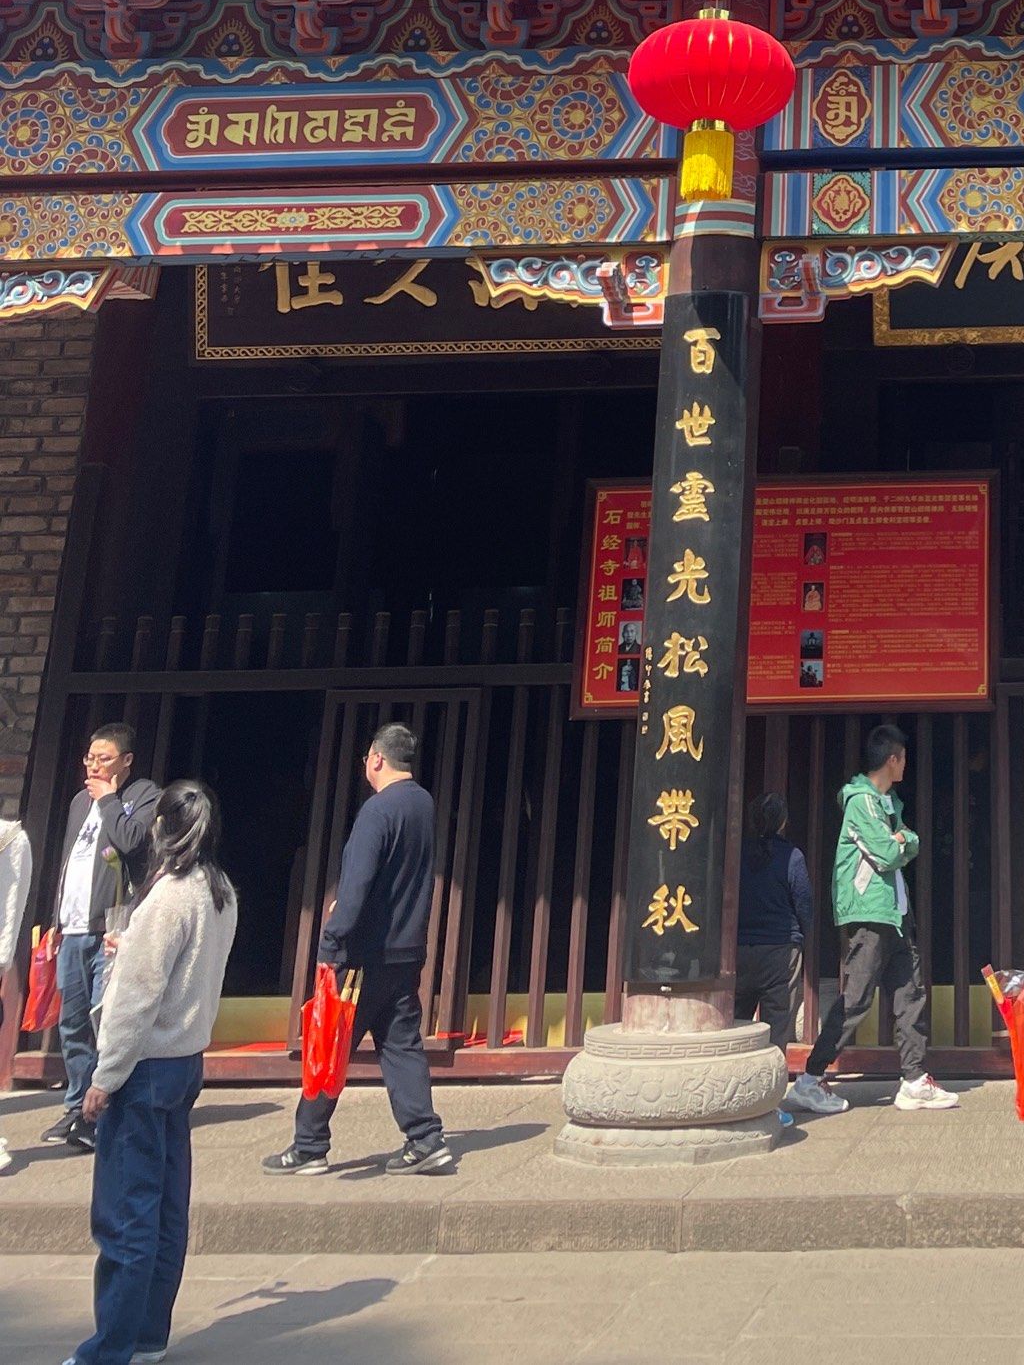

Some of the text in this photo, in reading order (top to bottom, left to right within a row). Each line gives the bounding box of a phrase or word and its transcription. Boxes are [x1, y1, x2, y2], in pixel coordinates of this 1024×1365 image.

[592, 508, 624, 681] 石经寺祖师简介
